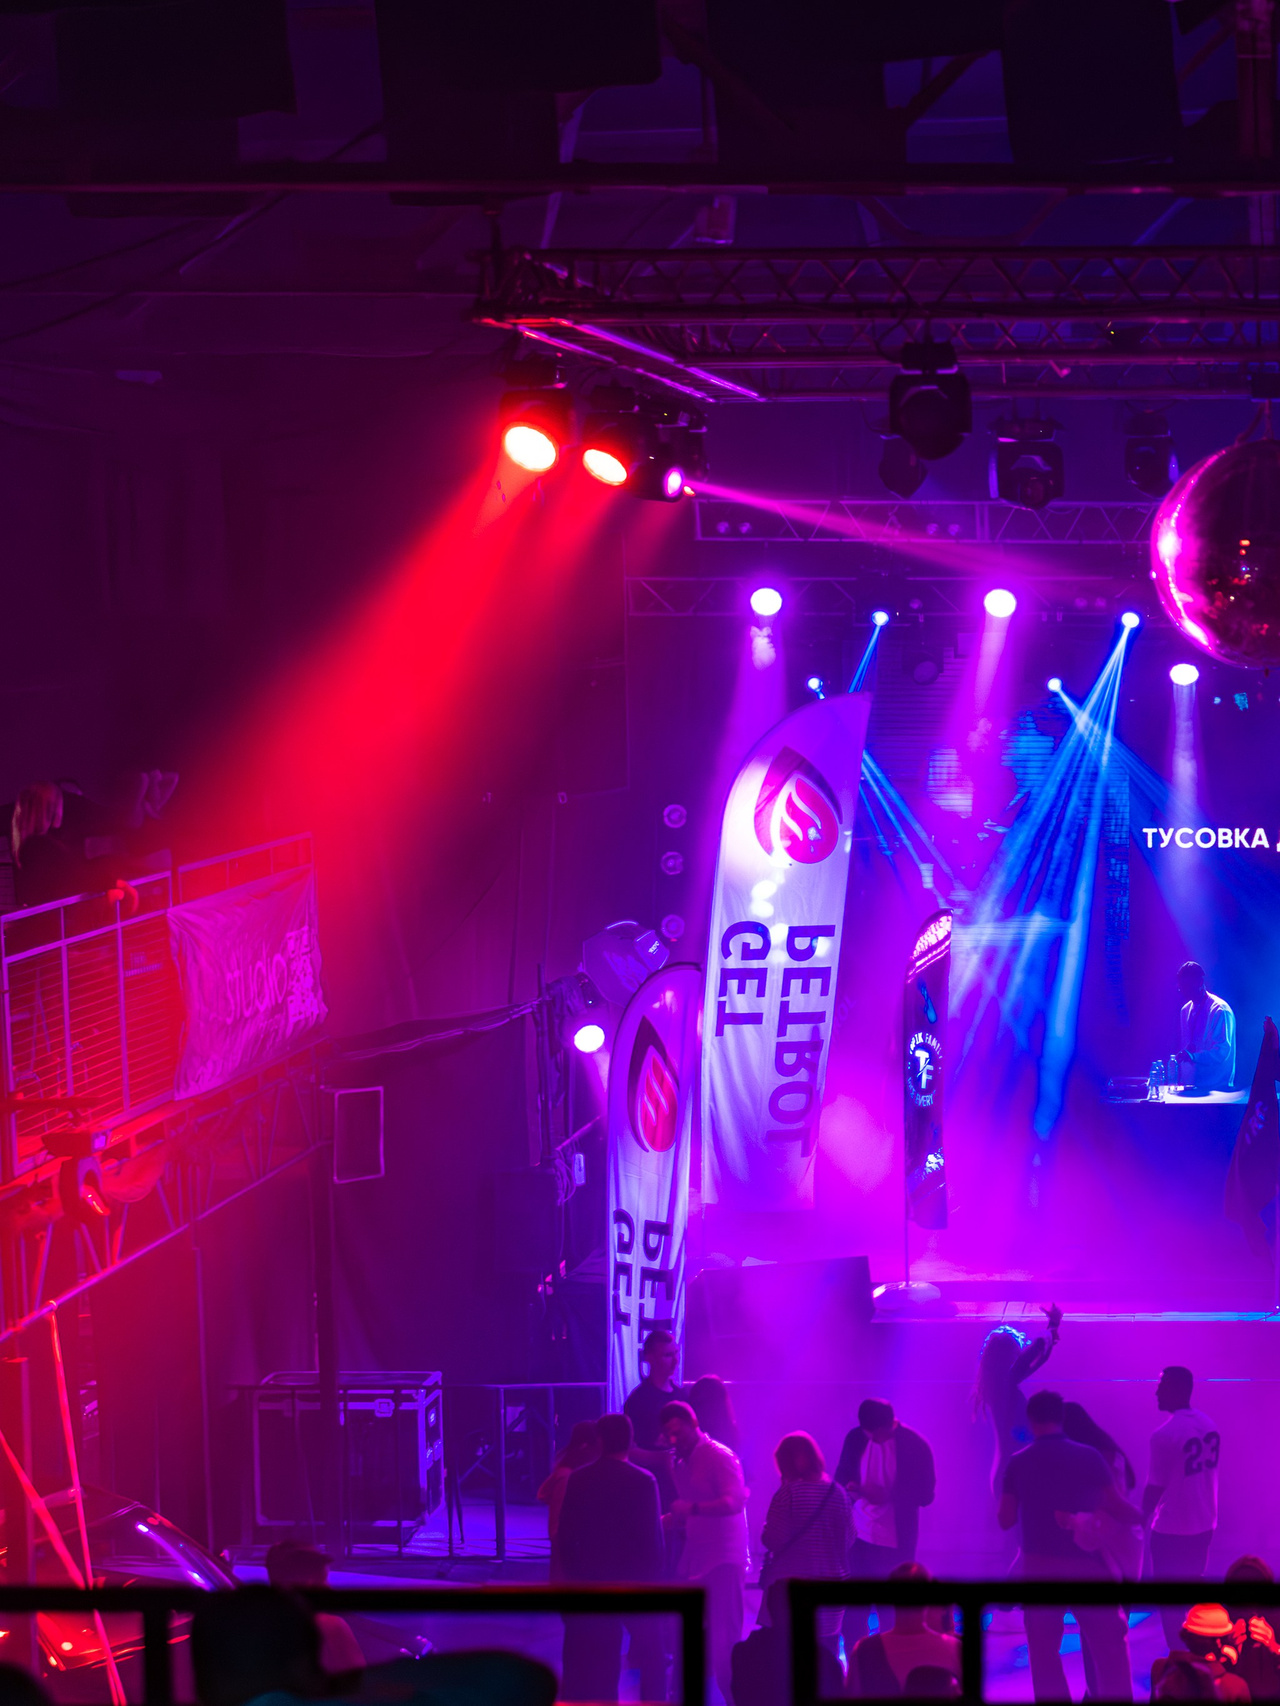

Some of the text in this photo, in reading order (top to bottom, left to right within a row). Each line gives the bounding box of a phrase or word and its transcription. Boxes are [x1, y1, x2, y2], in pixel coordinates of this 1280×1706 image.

[1142, 827, 1270, 848] ТУСОВКА
[915, 1050, 934, 1089] TF
[1182, 1430, 1221, 1478] 23
